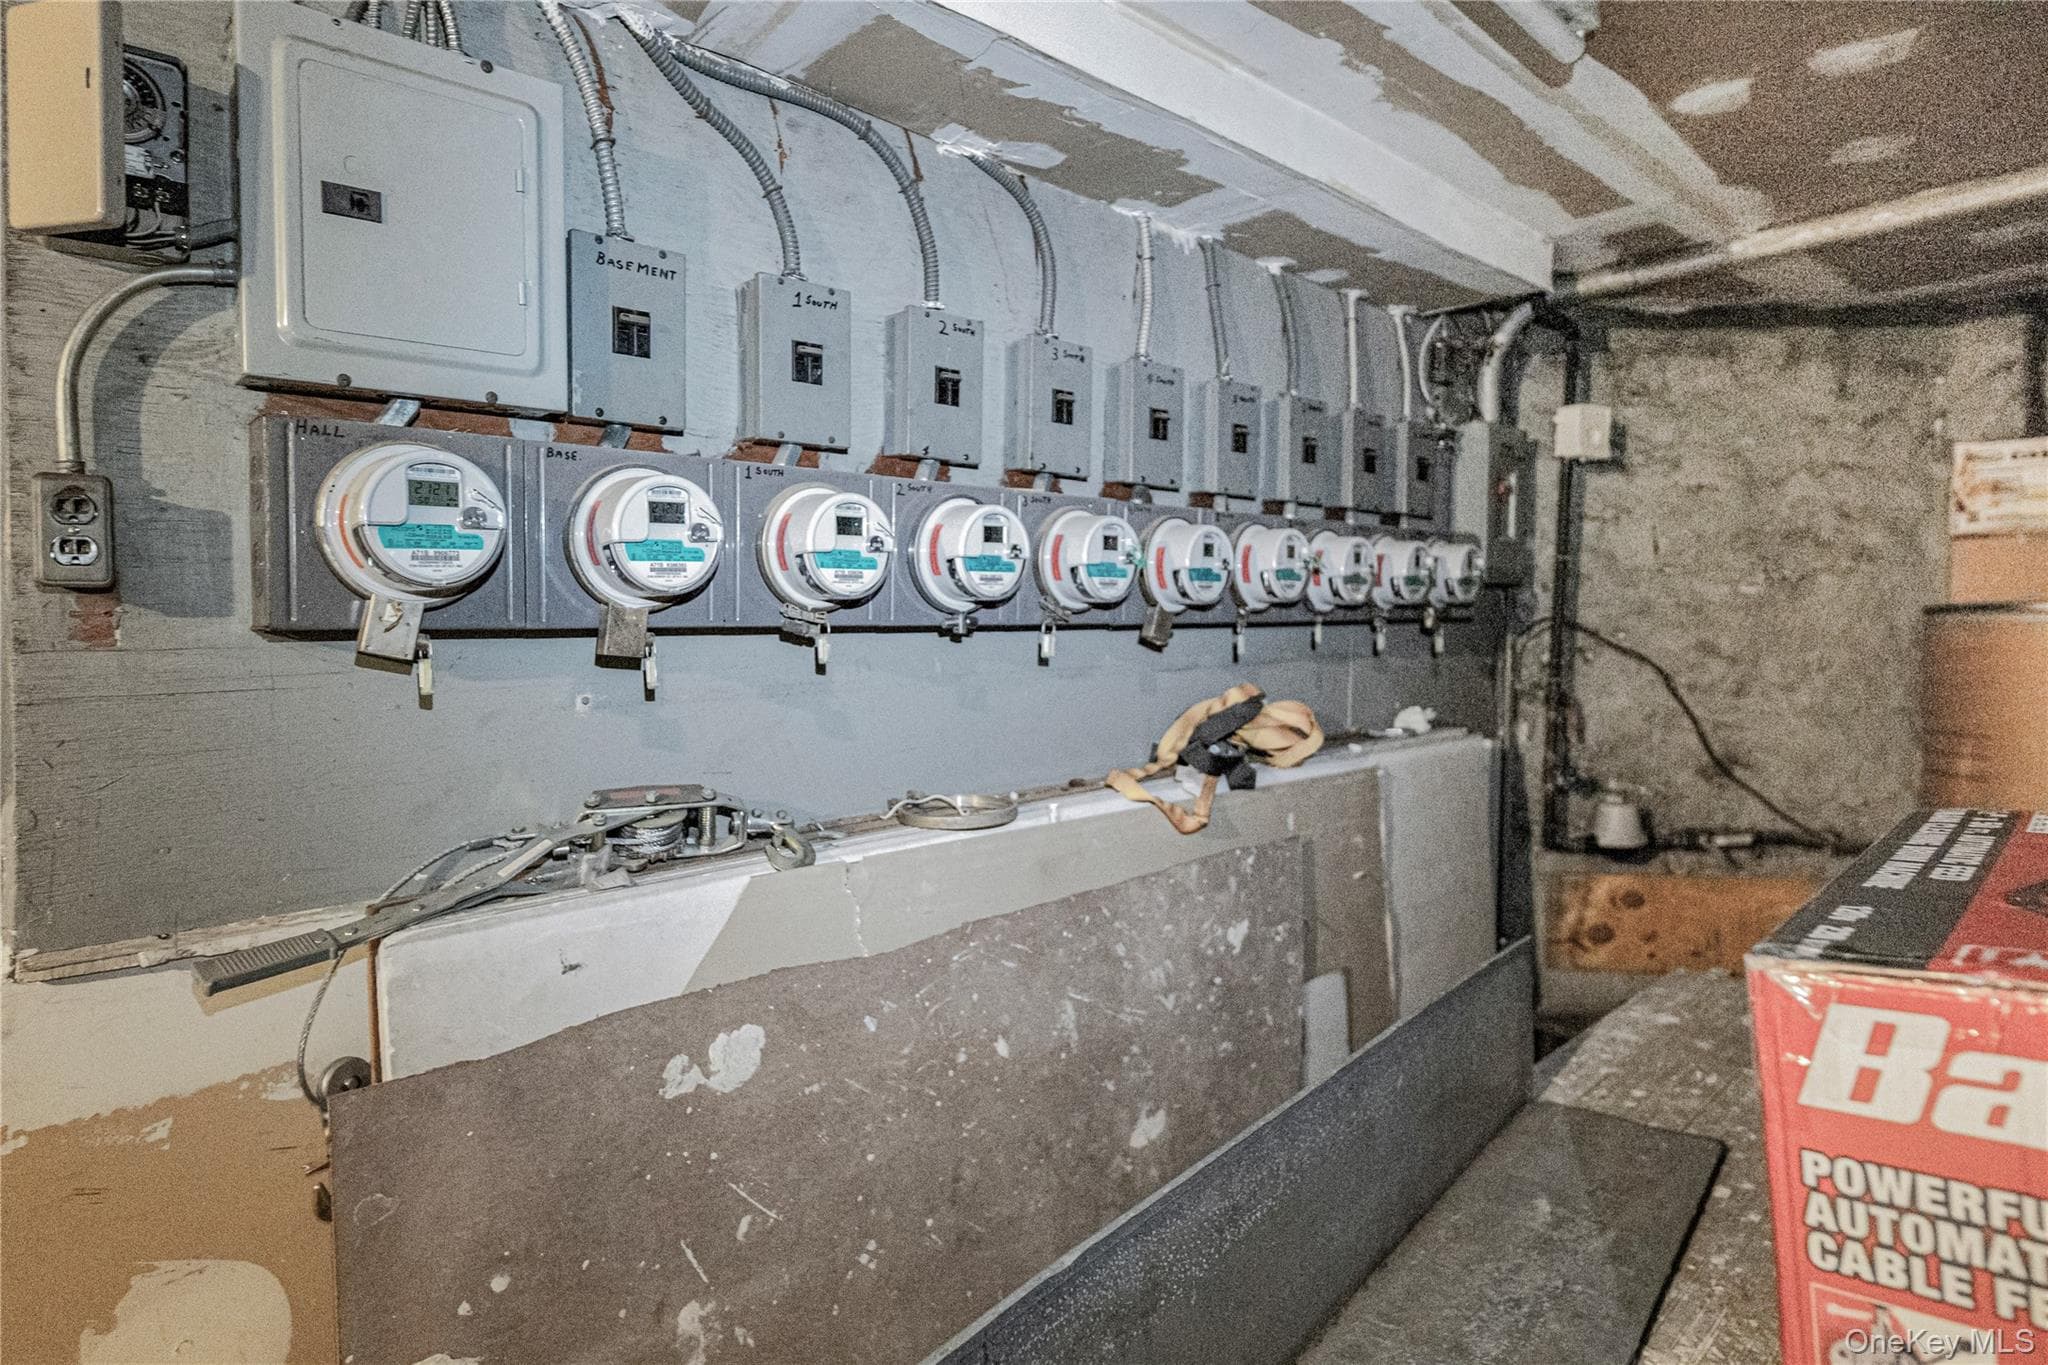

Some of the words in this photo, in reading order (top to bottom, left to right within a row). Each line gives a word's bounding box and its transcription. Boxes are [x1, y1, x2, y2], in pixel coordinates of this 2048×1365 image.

[596, 250, 678, 281] BASEMENT
[792, 291, 802, 308] 1
[805, 294, 839, 311] SOUTH
[938, 319, 950, 336] 2
[1051, 346, 1059, 361] 3
[295, 419, 345, 438] HALL
[745, 465, 752, 479] 1
[755, 466, 784, 477] SOUTH
[896, 482, 906, 496] 2
[1800, 1148, 2048, 1245] POWERFU
[1803, 1189, 2048, 1289] AUTOMAT
[1806, 1230, 1976, 1310] CABLE
